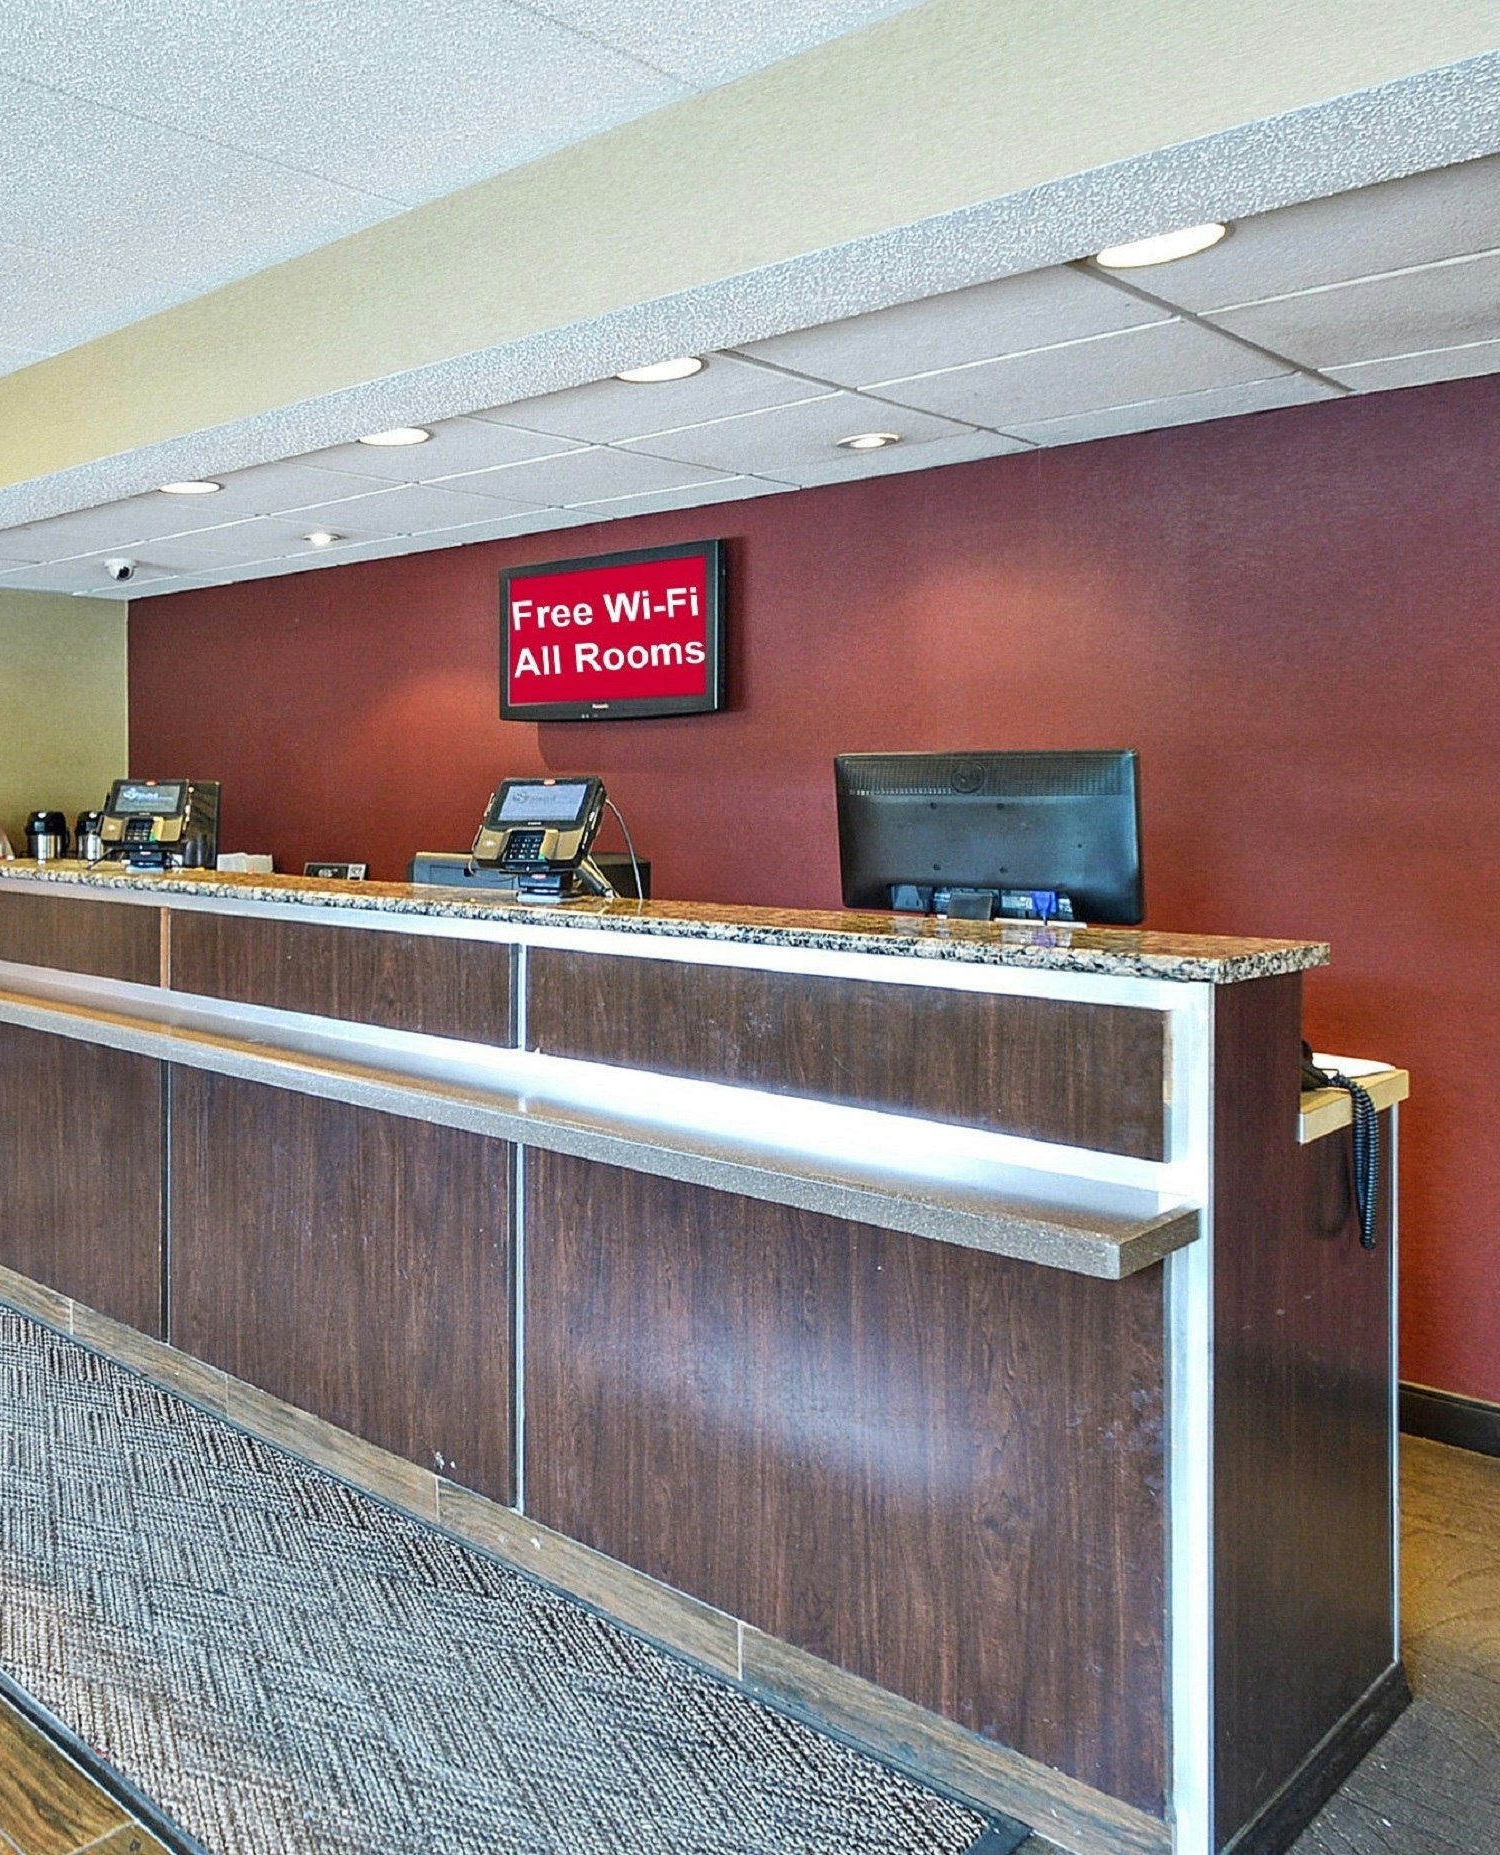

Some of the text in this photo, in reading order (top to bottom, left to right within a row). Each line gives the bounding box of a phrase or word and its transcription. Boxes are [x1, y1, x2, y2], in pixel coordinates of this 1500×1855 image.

[511, 586, 699, 631] Free Wi-Fi
[514, 640, 706, 678] All Rooms
